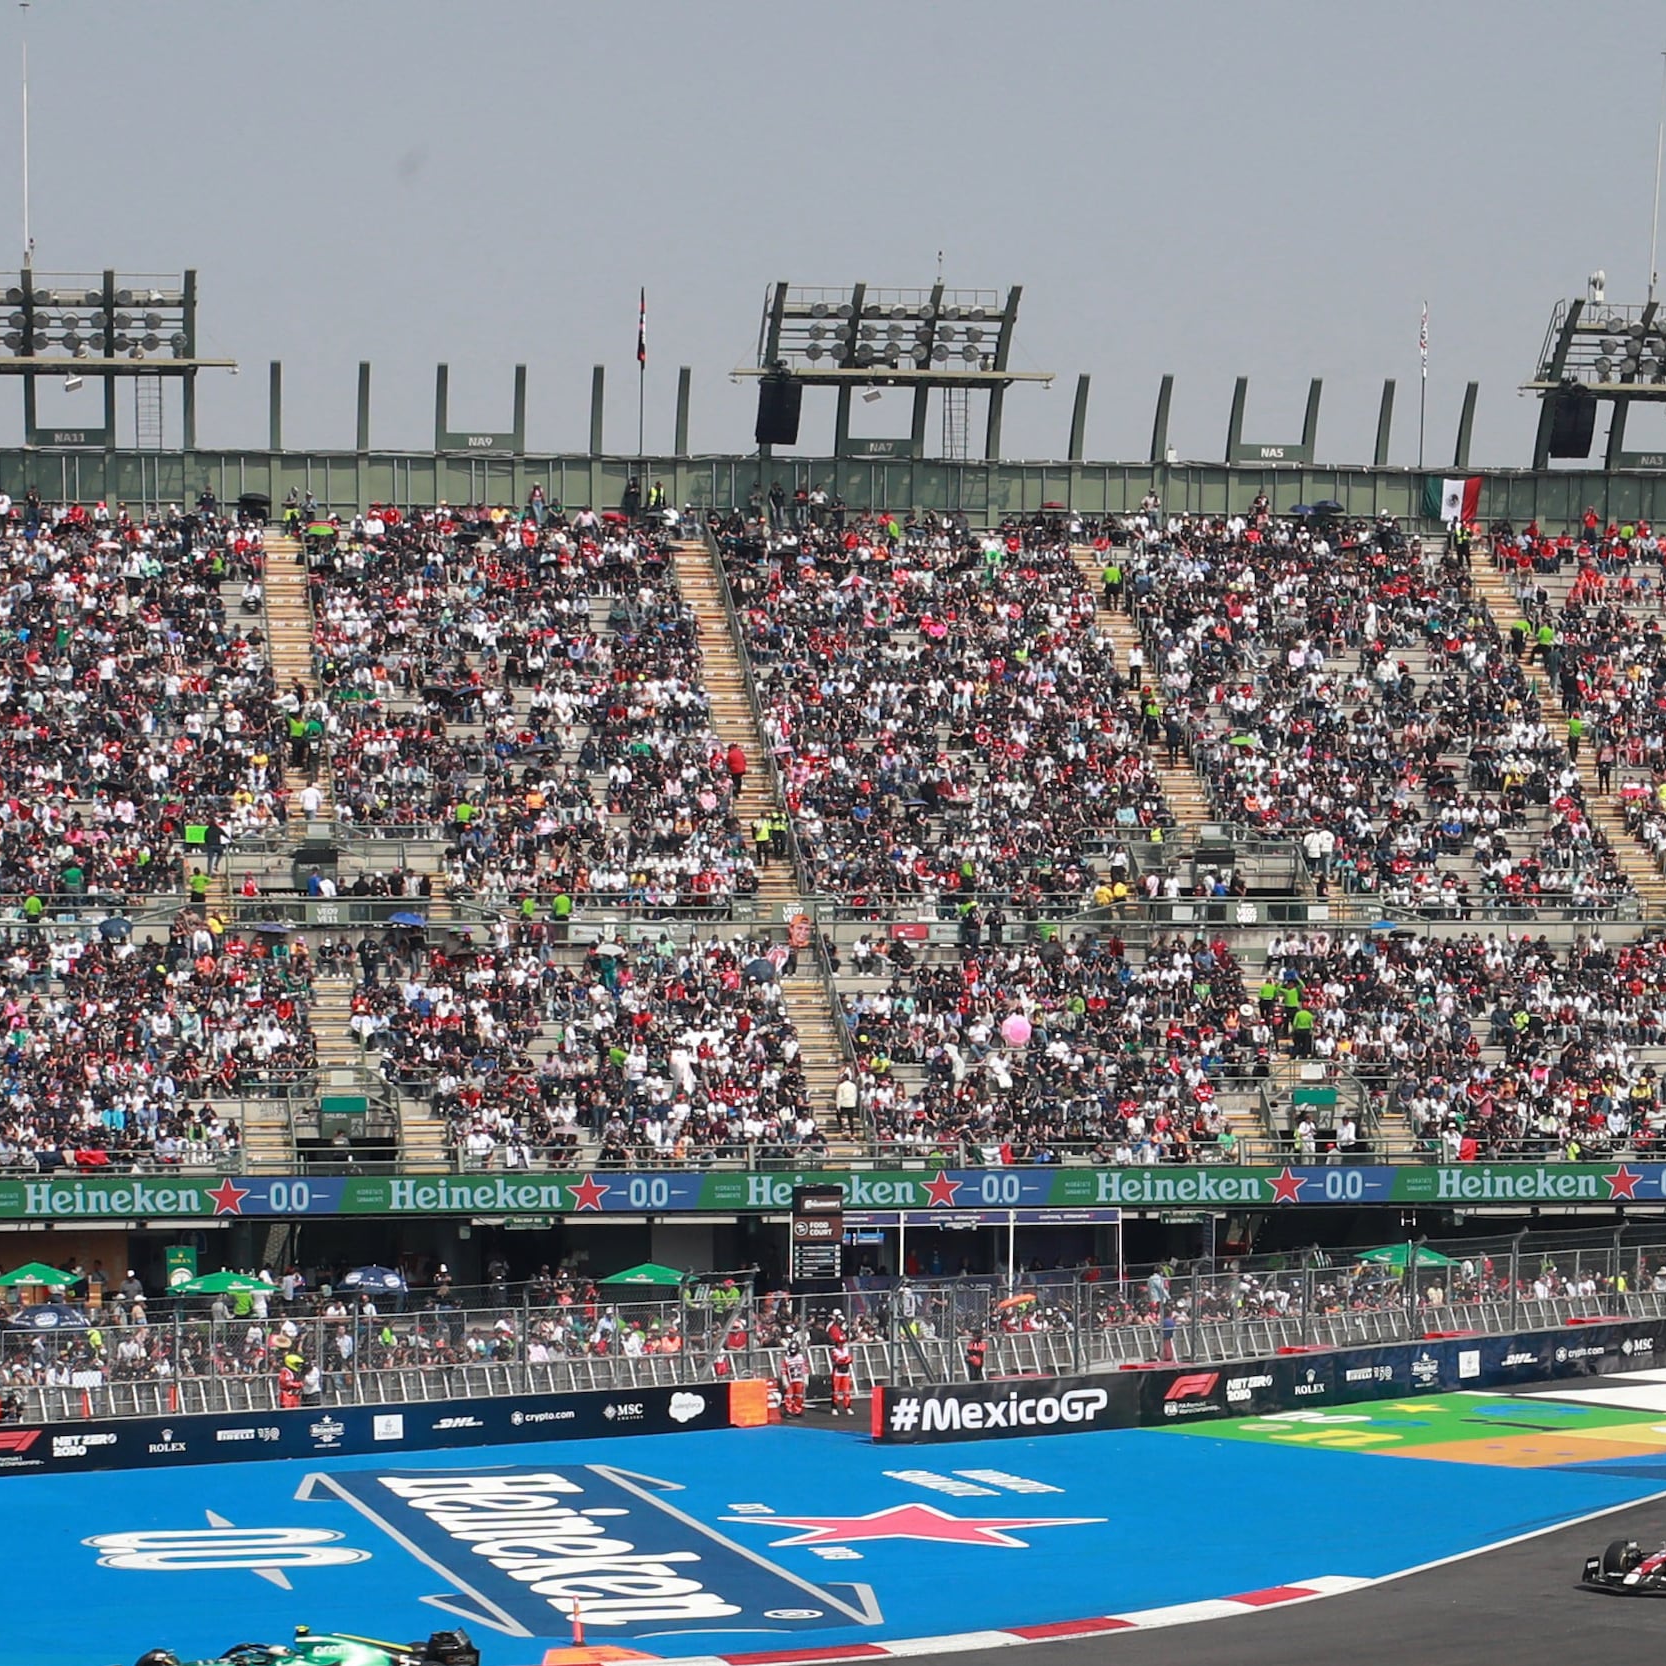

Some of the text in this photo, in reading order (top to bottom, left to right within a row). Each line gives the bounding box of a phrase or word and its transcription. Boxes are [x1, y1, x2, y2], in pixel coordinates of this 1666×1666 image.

[54, 433, 86, 443] NA11
[468, 437, 493, 446] NA9
[869, 443, 894, 453] NA7
[1261, 448, 1284, 458] NA5
[1641, 456, 1664, 466] NA3
[1097, 1172, 1261, 1202] Heineken
[1325, 1171, 1363, 1200] 0.0
[1437, 1168, 1598, 1198] Heineken
[24, 1183, 201, 1214] Heineken
[270, 1181, 309, 1212] 0.0
[389, 1179, 562, 1210] Heineken
[630, 1177, 669, 1208] 0.0
[747, 1176, 915, 1206] Heeken
[982, 1175, 1020, 1204] 0.0
[809, 1228, 833, 1236] COURT
[1633, 1338, 1654, 1351] MSC
[1226, 1374, 1273, 1392] NET ZERO
[1295, 1384, 1325, 1396] ROLEX
[1226, 1389, 1252, 1403] 2030
[524, 1409, 575, 1423] crypto.com
[617, 1403, 644, 1415] MSC
[889, 1387, 1109, 1432] #MexicoGP
[439, 1415, 475, 1429] DHL
[53, 1431, 117, 1448] NET ZERO
[53, 1445, 87, 1458] 2030
[149, 1441, 186, 1454] ROLEX
[376, 1471, 742, 1627] Heineken
